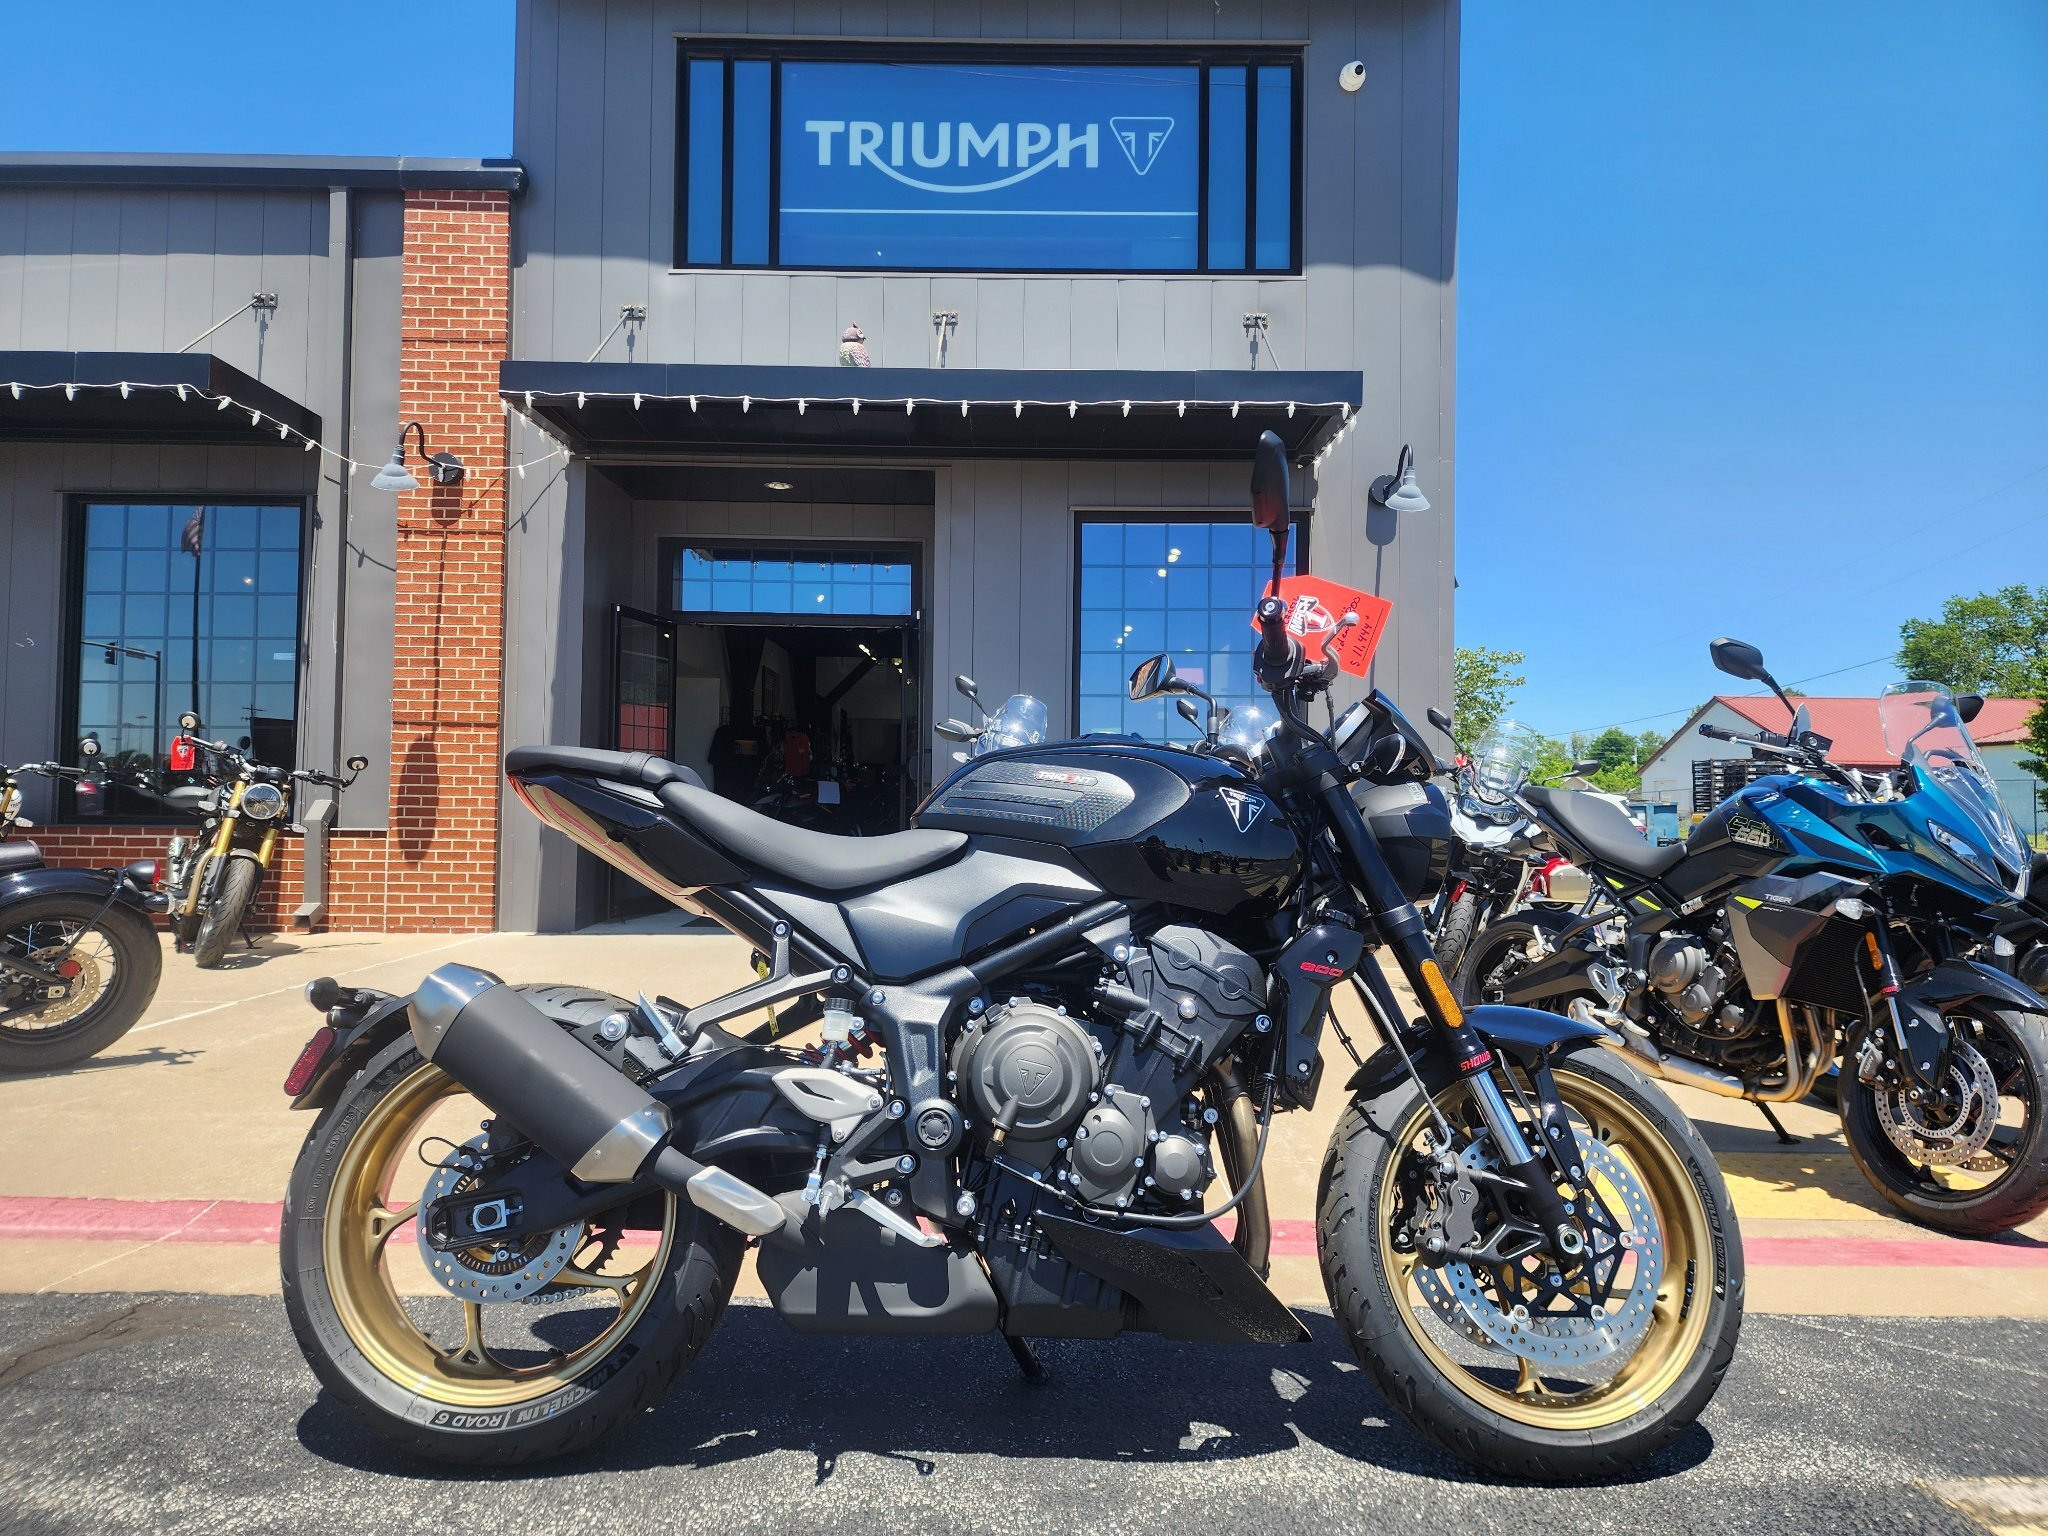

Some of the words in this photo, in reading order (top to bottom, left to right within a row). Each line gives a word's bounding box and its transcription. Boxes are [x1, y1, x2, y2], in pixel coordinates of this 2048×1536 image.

[805, 120, 1099, 193] TRIUMPH
[1288, 597, 1317, 634] MACH
[1036, 770, 1094, 786] TRIDENT
[1229, 791, 1257, 804] TRIUMPH
[1764, 893, 1792, 904] TIGER
[1300, 961, 1344, 977] 800
[1460, 1050, 1492, 1072] SHOWA
[1696, 1175, 1720, 1230] MICHELIN
[1372, 1251, 1391, 1308] MICHELIN
[516, 1367, 608, 1423] MICHELIN
[435, 1412, 448, 1425] 6
[452, 1411, 504, 1428] ROAD
